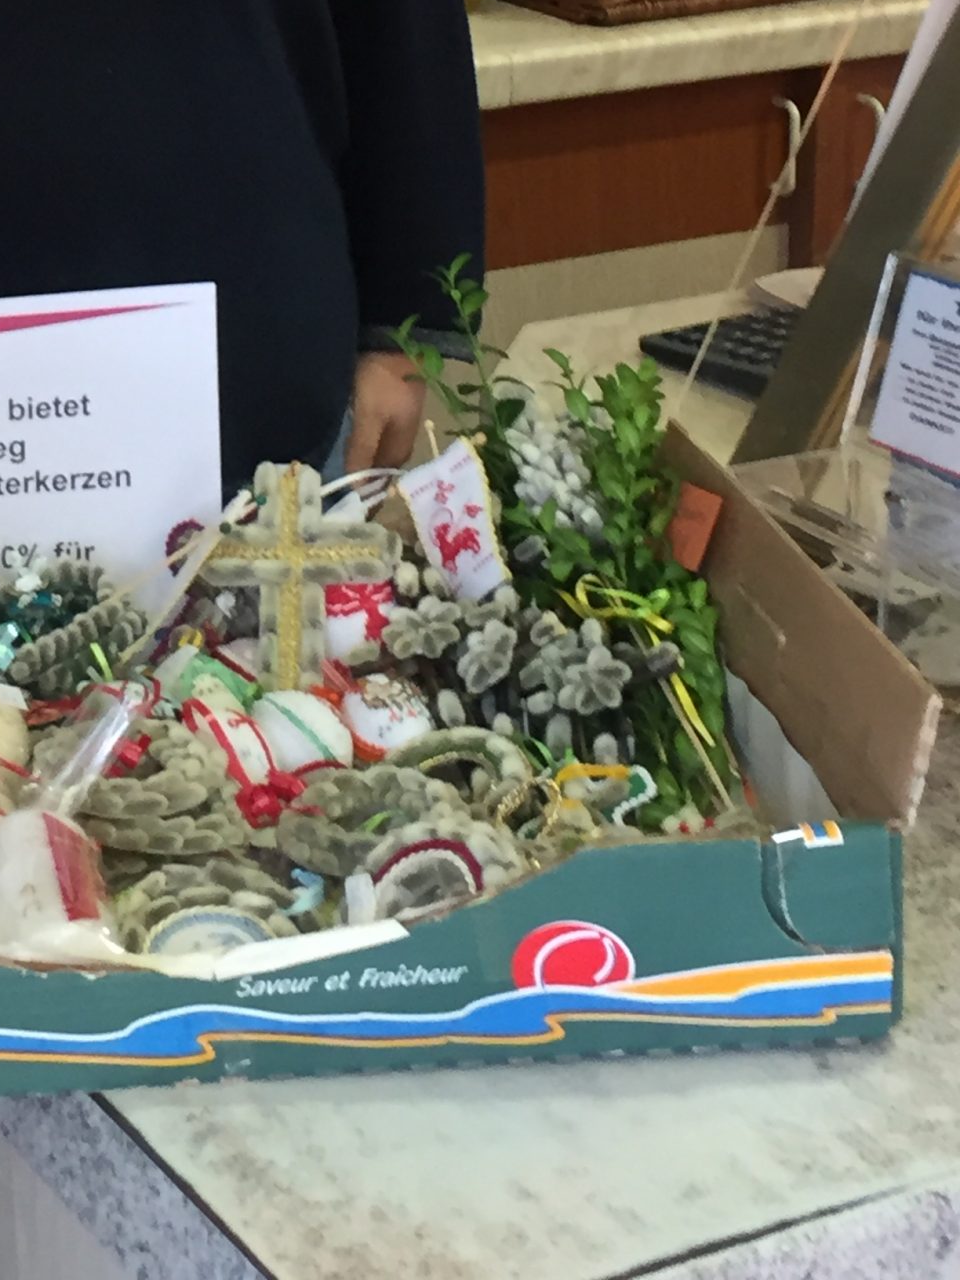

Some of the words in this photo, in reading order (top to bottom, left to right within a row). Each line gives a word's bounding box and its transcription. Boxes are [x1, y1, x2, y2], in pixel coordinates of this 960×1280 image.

[7, 393, 91, 421] bietet
[236, 974, 319, 999] Saveur
[324, 970, 351, 992] et
[358, 963, 469, 989] Fraîcheur
